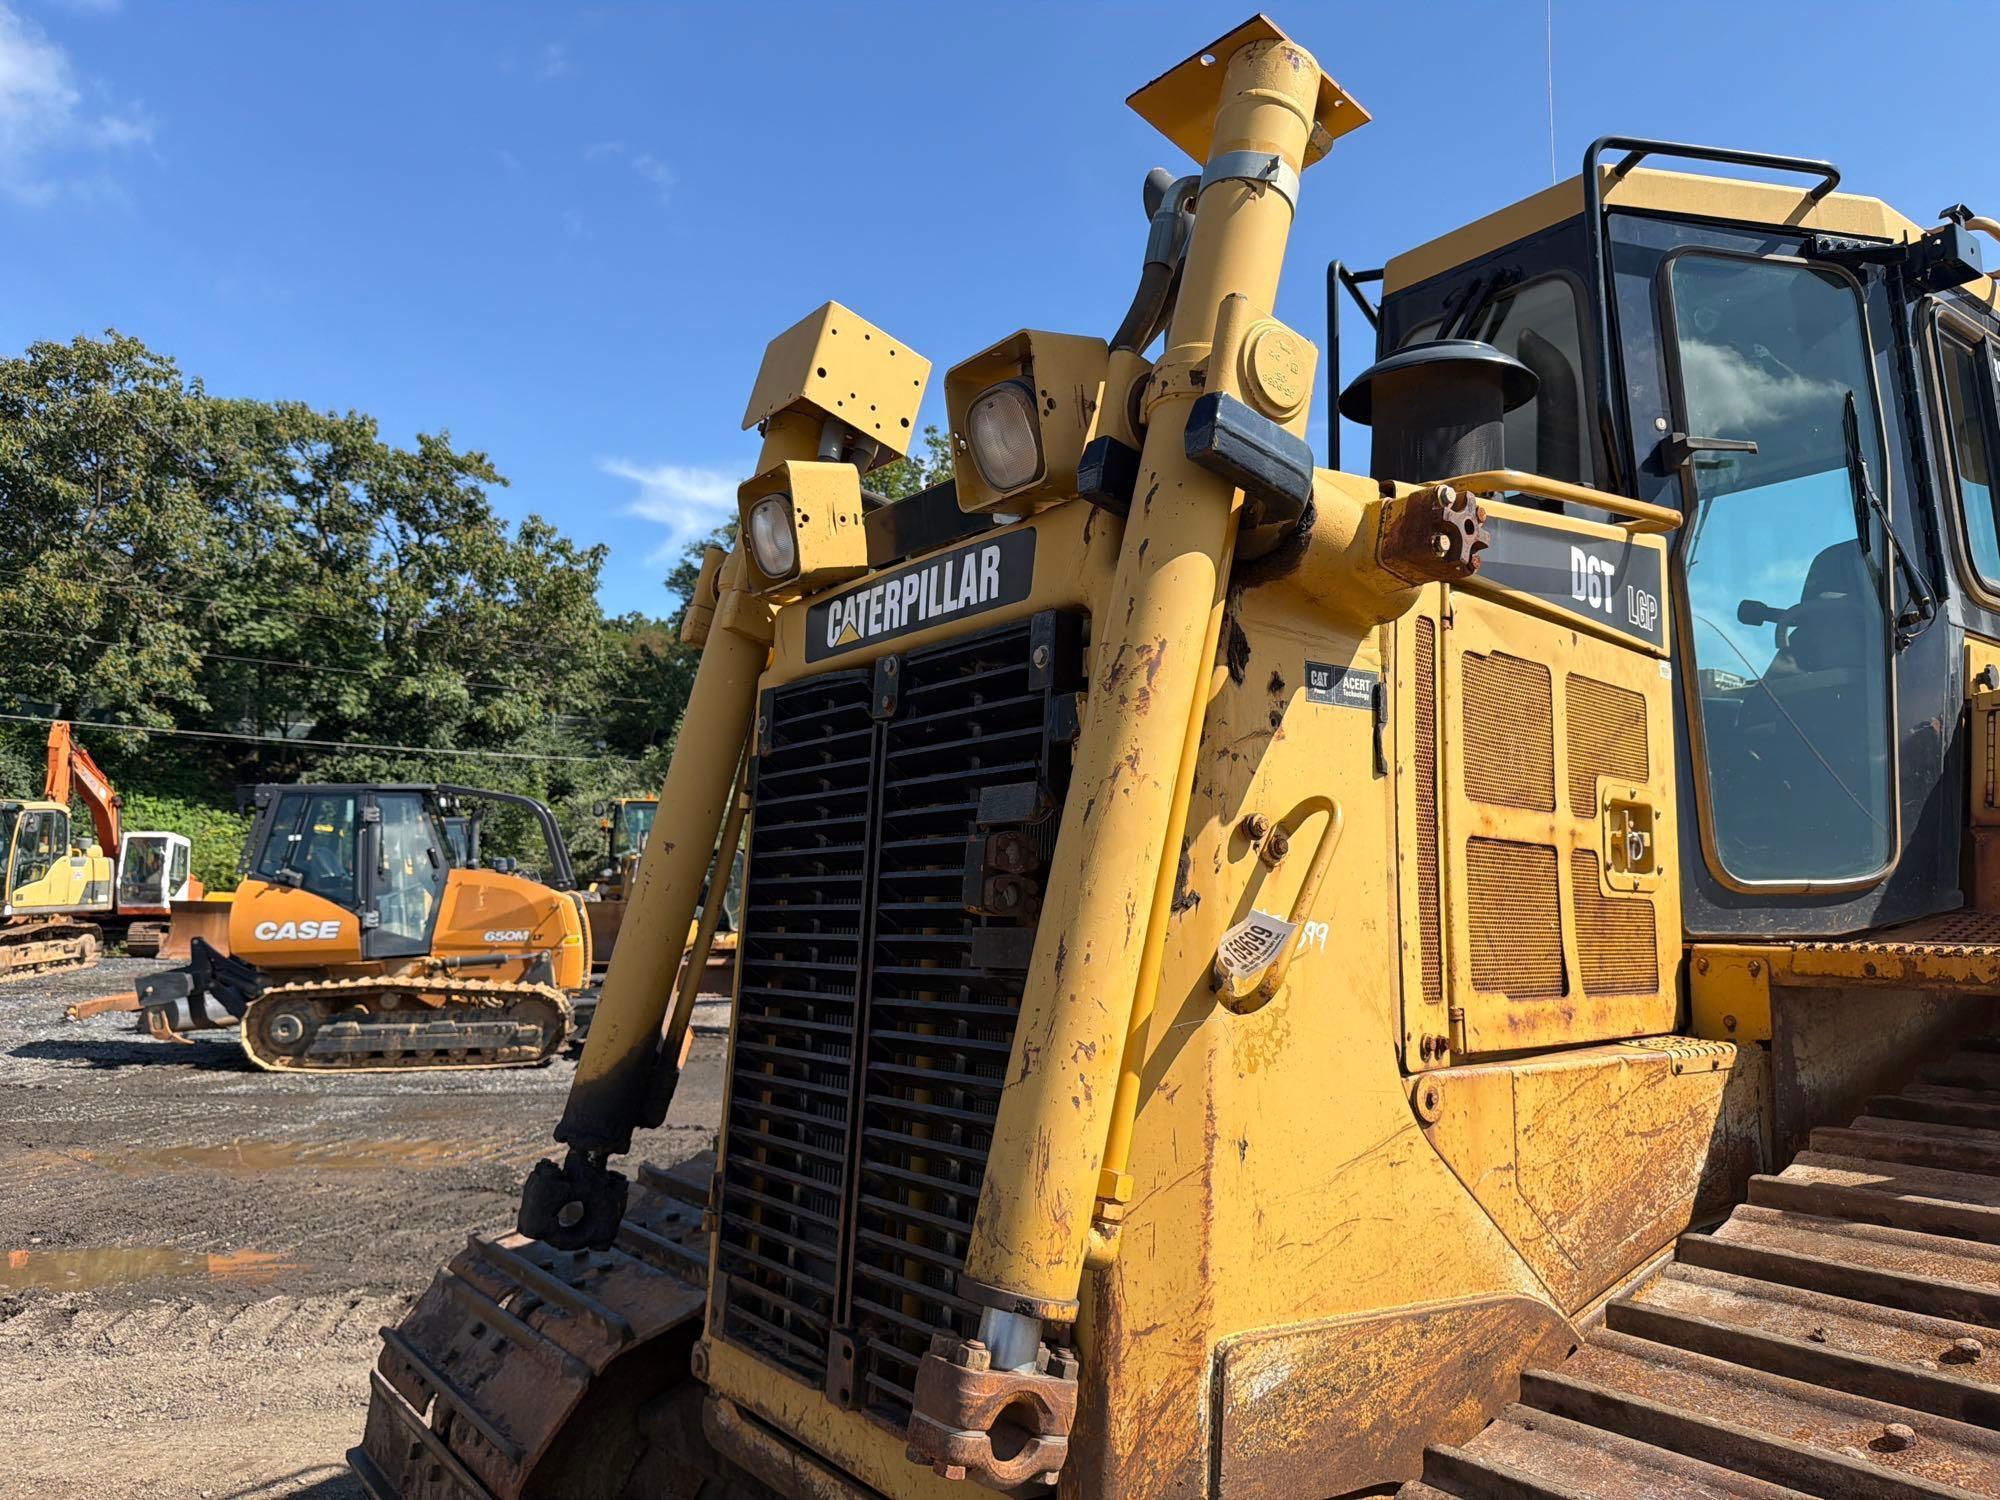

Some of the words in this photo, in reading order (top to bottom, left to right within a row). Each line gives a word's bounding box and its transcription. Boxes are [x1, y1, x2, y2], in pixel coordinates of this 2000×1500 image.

[826, 545, 1001, 648] CATERPILLAR
[1571, 545, 1615, 614] D6T
[1627, 585, 1658, 632] LGP
[1311, 670, 1328, 687] CAT
[1343, 677, 1370, 692] ACERT
[1343, 688, 1370, 700] Technology
[255, 921, 341, 940] CASE
[484, 930, 530, 942] 650M
[1224, 925, 1274, 963] 159699
